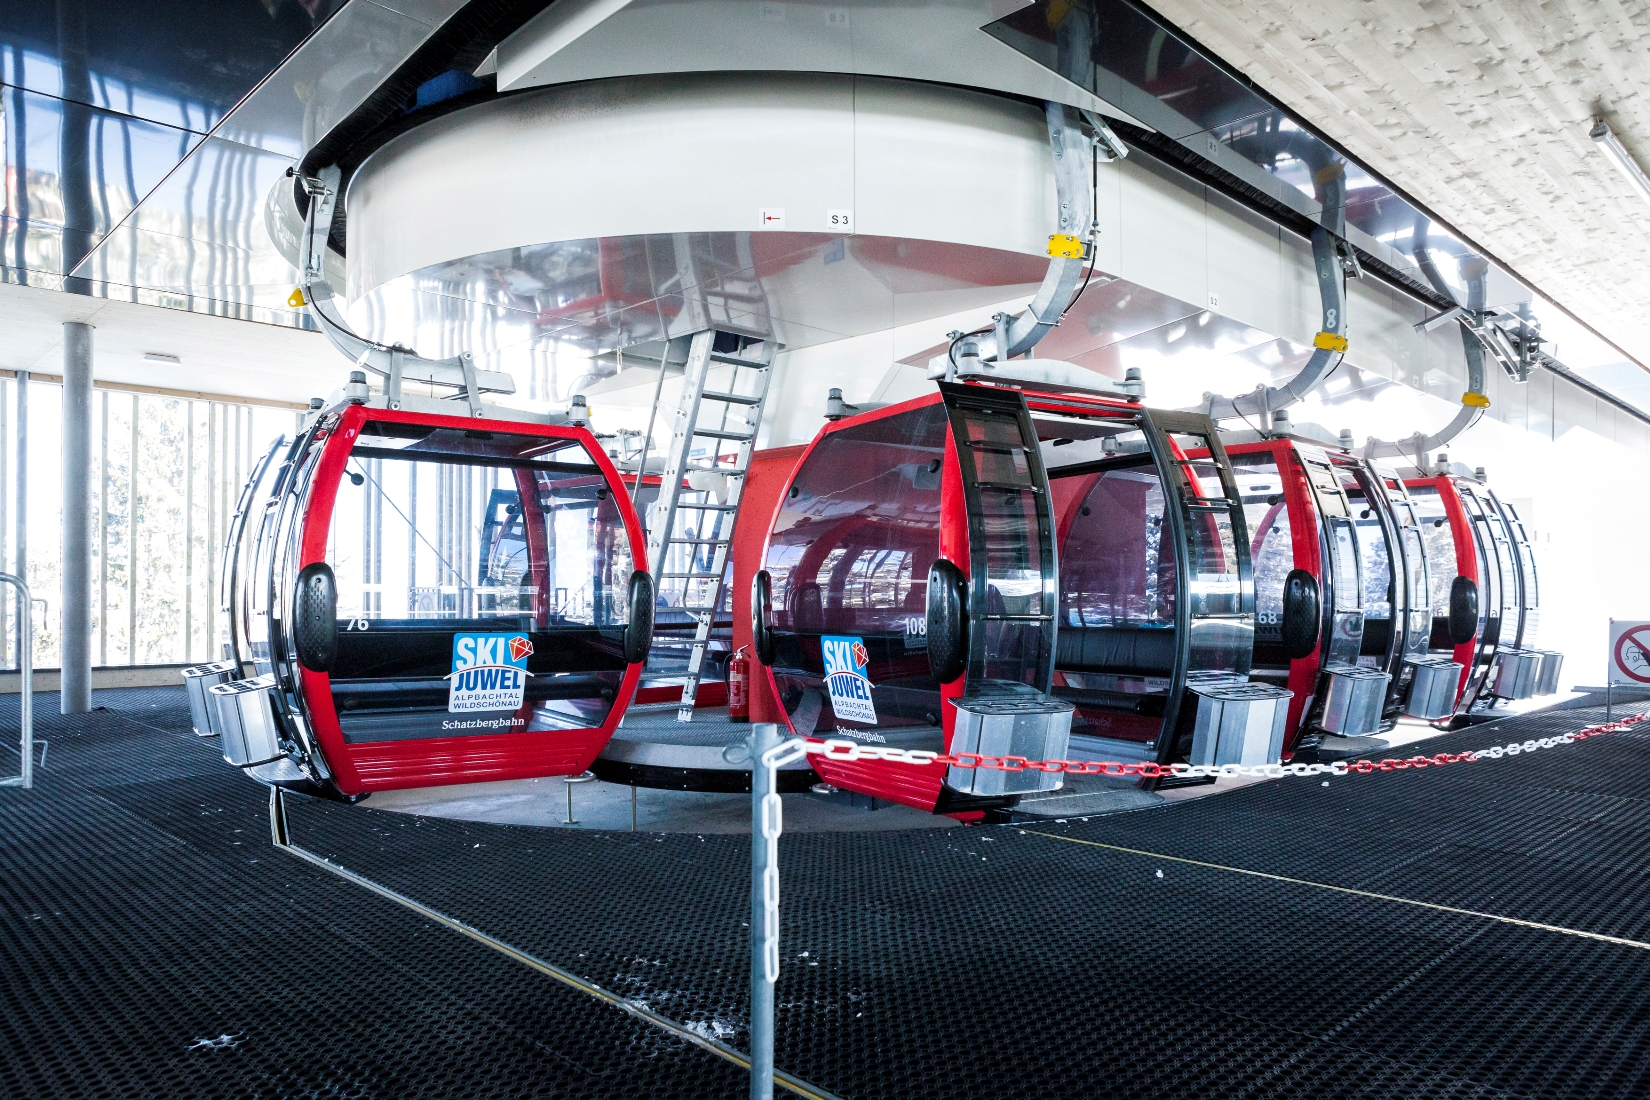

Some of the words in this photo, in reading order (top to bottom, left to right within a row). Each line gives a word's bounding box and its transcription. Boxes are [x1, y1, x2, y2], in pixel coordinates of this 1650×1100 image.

[831, 215, 839, 224] S
[842, 215, 849, 224] 3
[346, 615, 369, 631] 76
[1258, 611, 1278, 625] 68
[905, 617, 926, 636] 108
[455, 637, 506, 670] SKI
[823, 640, 854, 674] SKI
[454, 668, 521, 692] JUWEL
[830, 674, 870, 701] JUWEL
[453, 692, 520, 702] ALPBACHTAL
[453, 700, 520, 710] WILDSCHÖNAU
[834, 699, 873, 712] ALPBACHTAL
[442, 717, 525, 730] Schatzbergbahn
[836, 726, 886, 743] Schatzbergbahn
